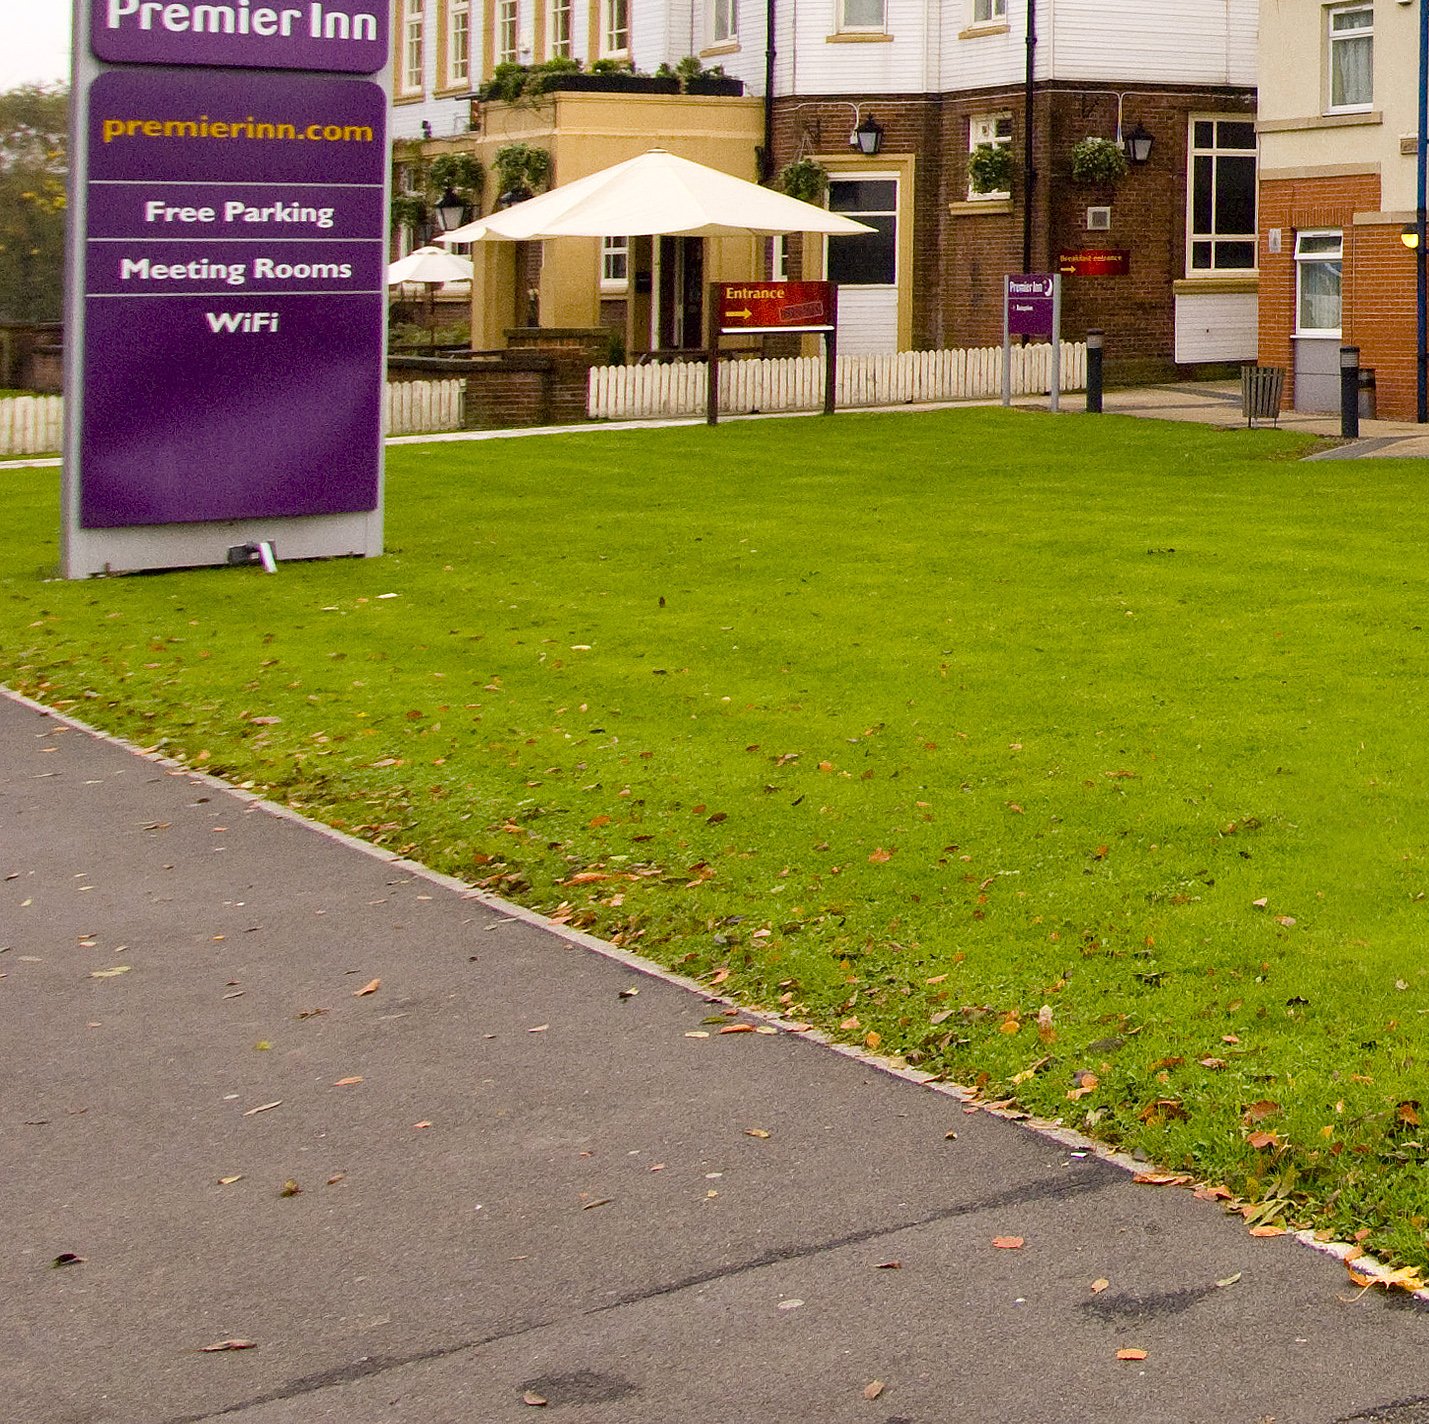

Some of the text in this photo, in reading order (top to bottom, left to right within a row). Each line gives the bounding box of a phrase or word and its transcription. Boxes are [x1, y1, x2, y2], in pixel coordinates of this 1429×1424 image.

[311, 2, 378, 41] Inn
[103, 115, 374, 143] premierinn.com
[145, 201, 335, 228] Free Parking
[120, 258, 352, 285] Meeting Rooms
[725, 287, 785, 299] Entrance
[206, 312, 280, 333] WiFi
